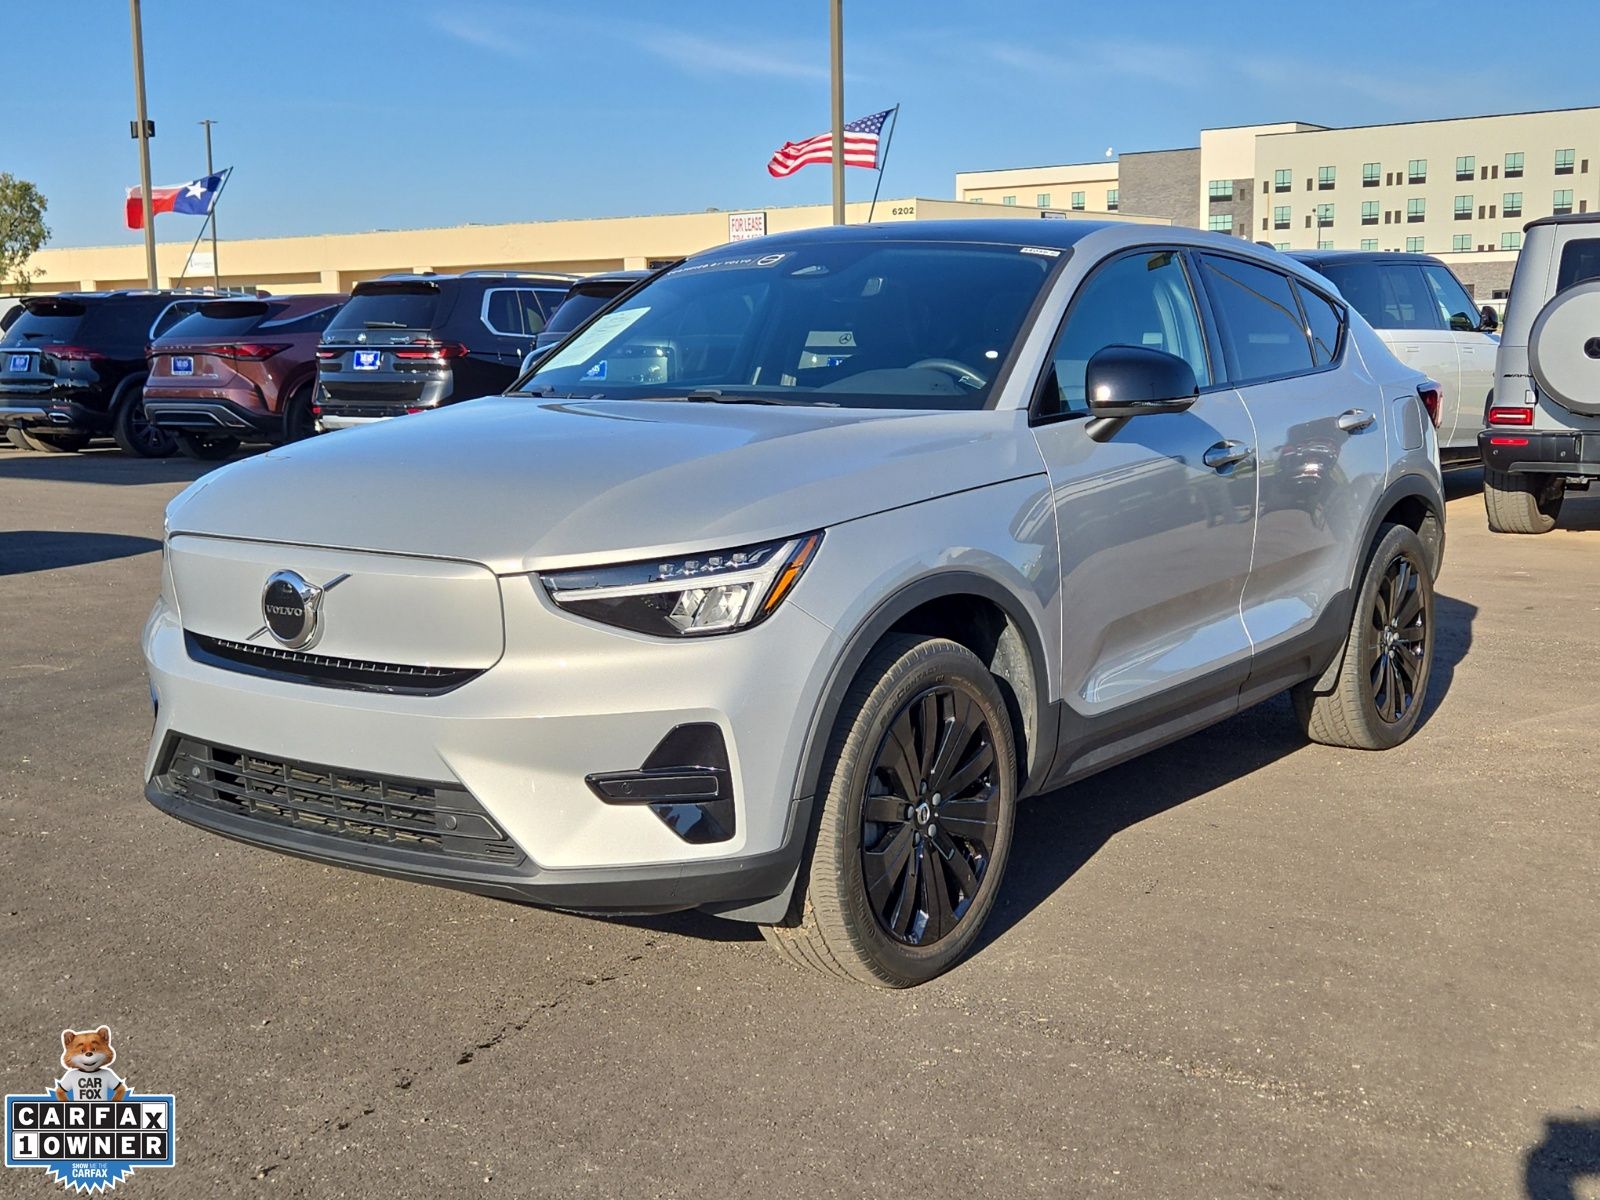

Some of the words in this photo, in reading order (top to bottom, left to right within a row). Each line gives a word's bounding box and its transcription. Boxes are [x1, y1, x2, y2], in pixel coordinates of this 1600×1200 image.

[892, 206, 914, 216] 6202
[731, 217, 743, 231] FOR
[744, 216, 762, 231] LEASE
[266, 604, 303, 617] VOLVO
